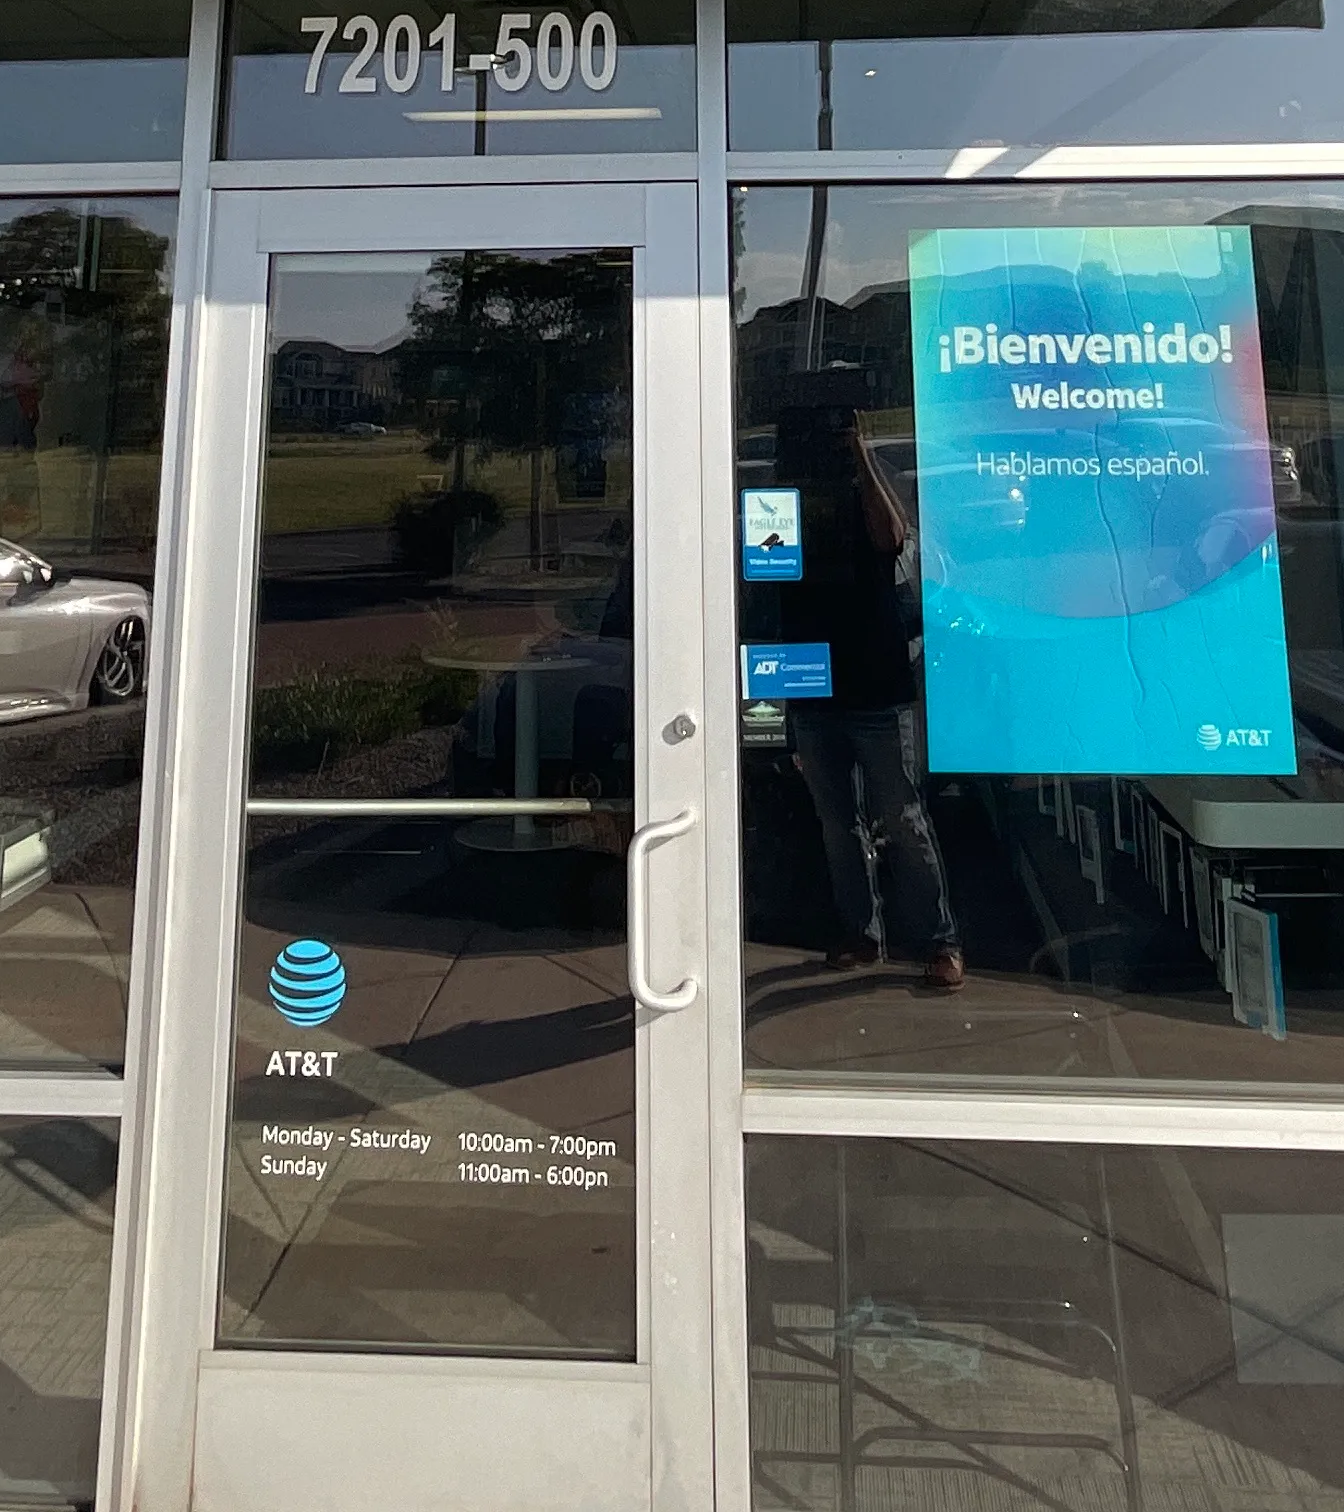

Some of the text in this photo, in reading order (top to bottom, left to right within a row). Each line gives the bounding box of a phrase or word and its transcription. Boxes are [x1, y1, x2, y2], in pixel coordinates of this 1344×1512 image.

[299, 10, 620, 94] 7201-500
[938, 322, 1233, 373] ¡Bienvenido!
[1011, 382, 1165, 410] Welcome!
[976, 451, 1210, 483] Hablamos español.
[753, 660, 779, 676] ADT
[1225, 728, 1273, 747] AT&T
[265, 1050, 339, 1077] AT&T
[261, 1124, 334, 1151] Monday
[349, 1127, 432, 1155] Saturday
[457, 1131, 533, 1154] 10:00am
[549, 1134, 617, 1161] 7:00pm
[260, 1154, 328, 1181] Sunday
[457, 1162, 530, 1184] 11:00am
